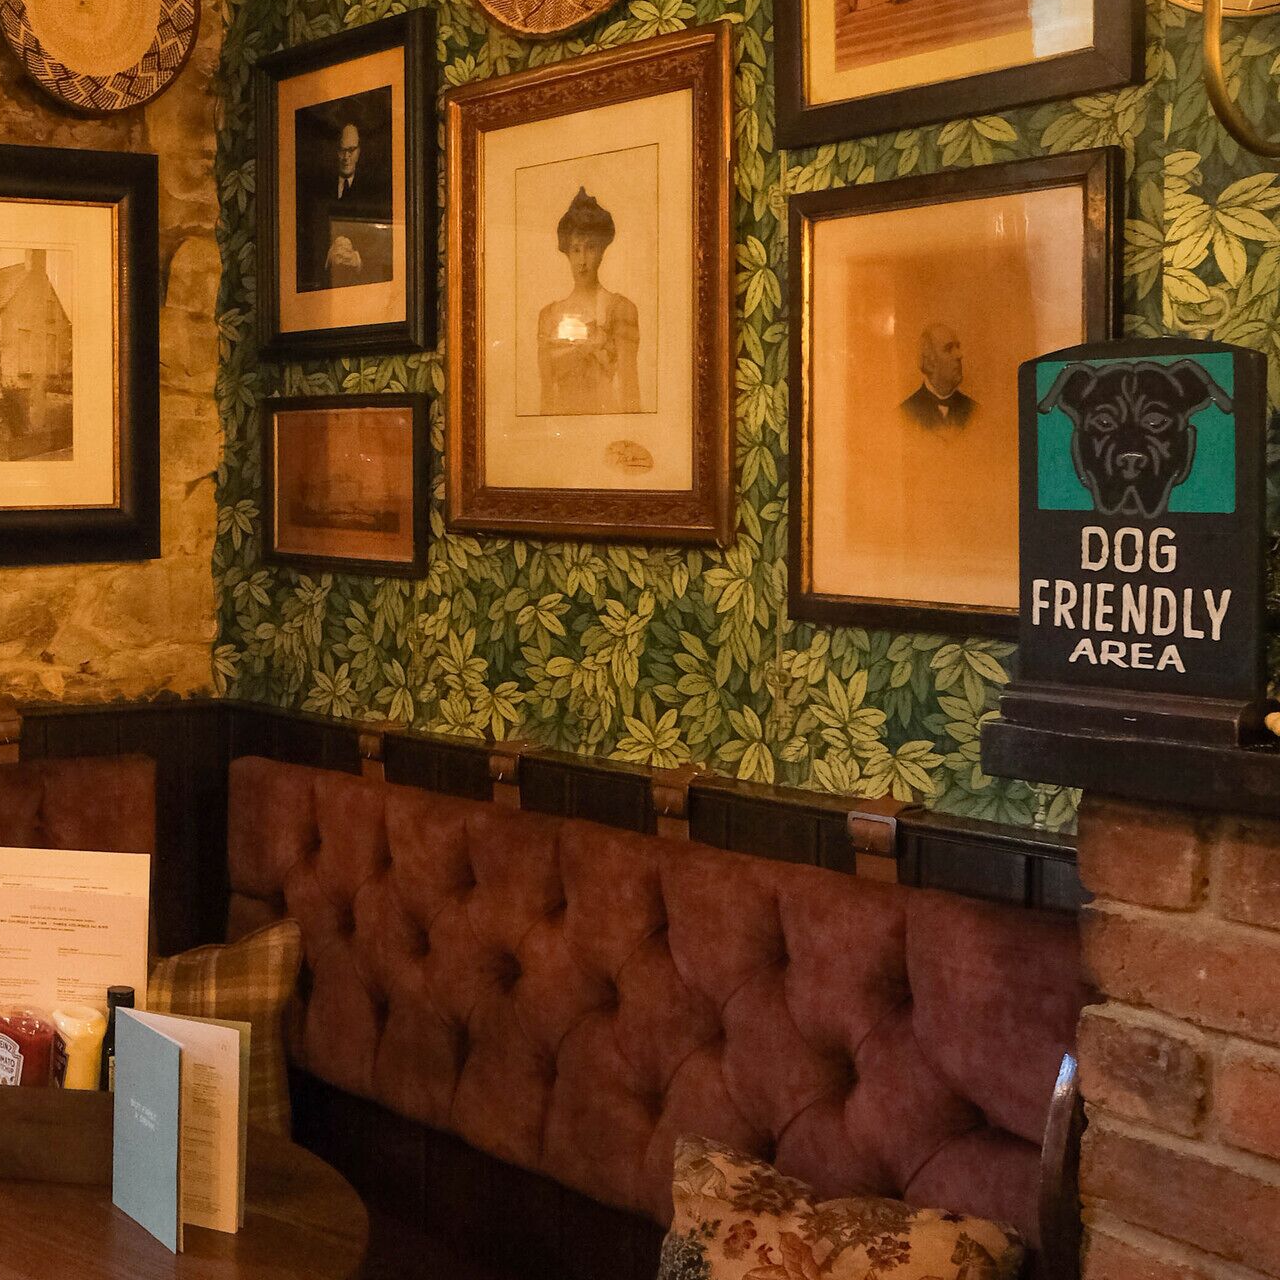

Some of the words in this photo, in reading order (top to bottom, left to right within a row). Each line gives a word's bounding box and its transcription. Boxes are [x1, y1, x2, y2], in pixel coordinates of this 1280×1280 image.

[1081, 526, 1177, 573] DOG
[1031, 579, 1232, 641] FRIENDLY
[1068, 637, 1186, 674] AREA
